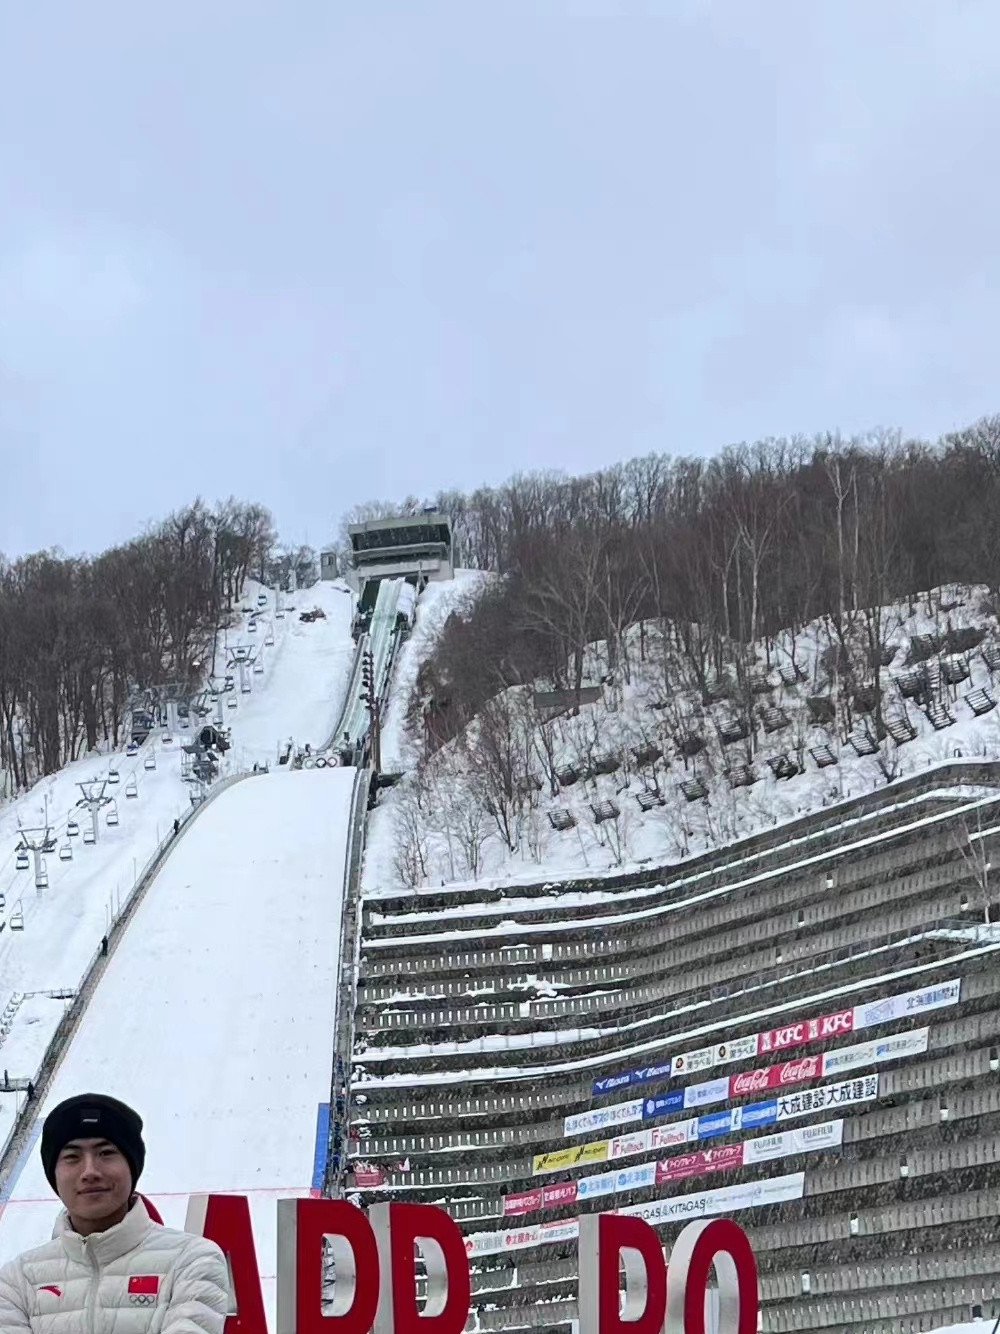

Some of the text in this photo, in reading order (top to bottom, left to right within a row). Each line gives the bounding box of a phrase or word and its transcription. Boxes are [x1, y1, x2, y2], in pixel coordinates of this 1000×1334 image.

[773, 1026, 804, 1046] KFC
[821, 1014, 852, 1035] KFC
[778, 1089, 826, 1117] 大成建設
[826, 1077, 877, 1106] 大成建設
[670, 1198, 706, 1217] KITAGAS
